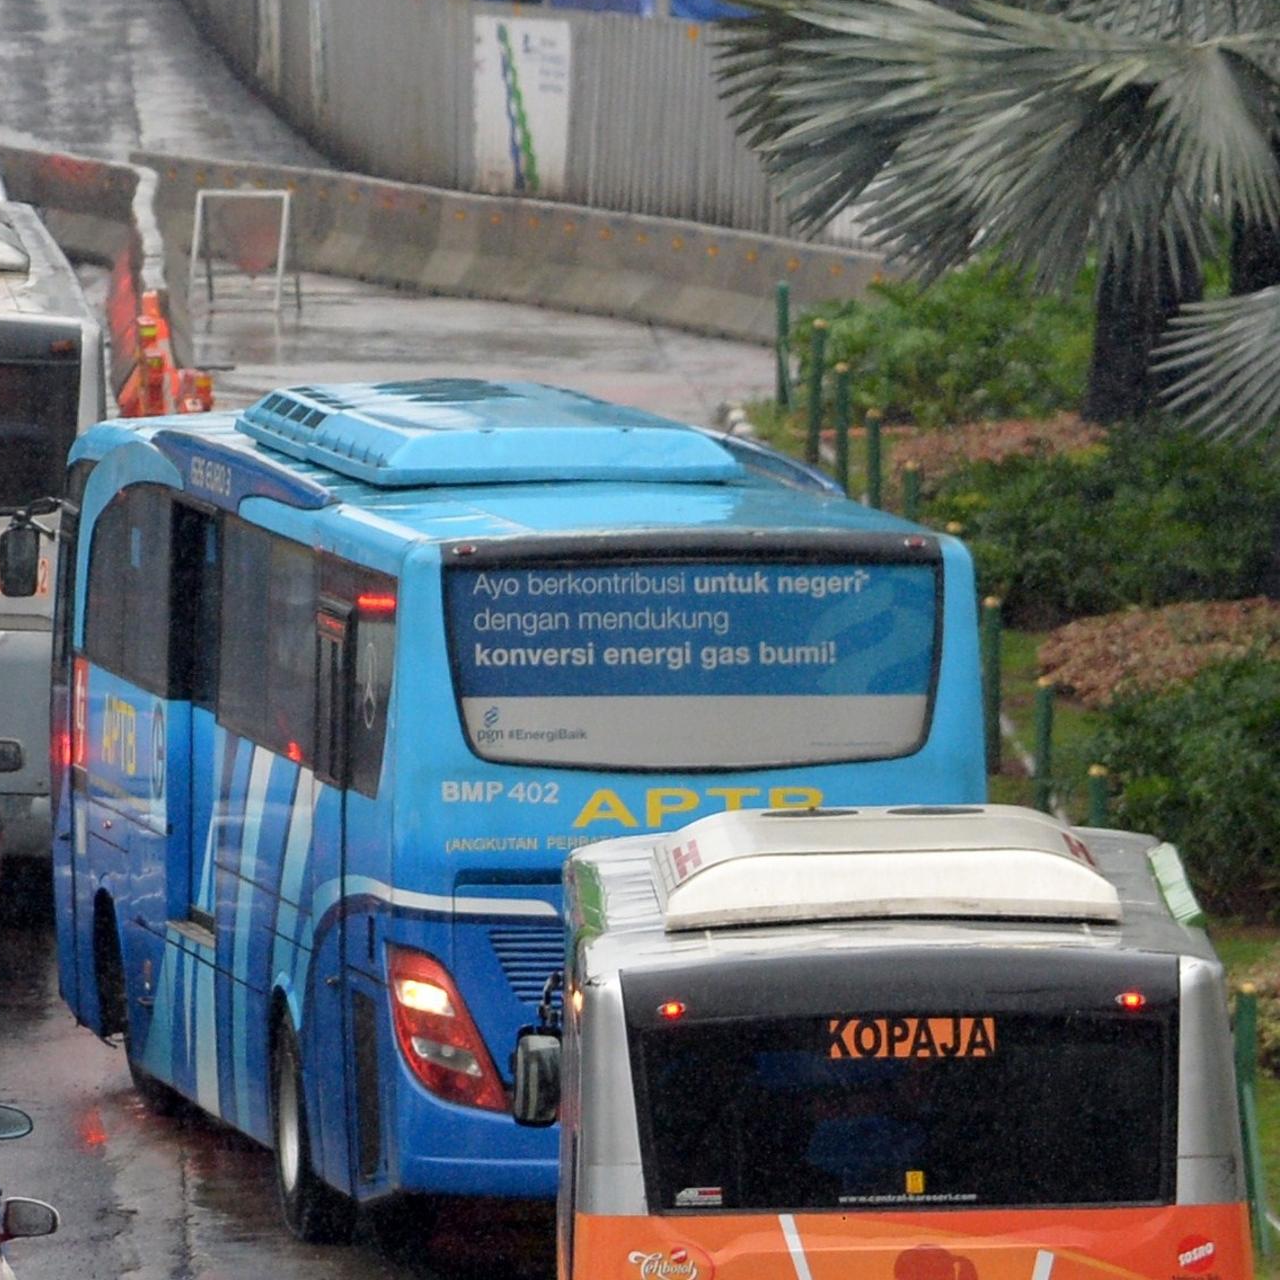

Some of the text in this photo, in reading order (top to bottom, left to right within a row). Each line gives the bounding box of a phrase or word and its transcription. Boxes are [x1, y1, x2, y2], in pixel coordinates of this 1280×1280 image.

[472, 573, 519, 600] Ayo
[528, 572, 686, 595] berkontribusi
[694, 572, 769, 594] untuk
[473, 608, 729, 636] dengan mendukung
[474, 641, 838, 670] konversi energi gas bumi!
[477, 728, 588, 743] pgn #EnergiBaik
[441, 781, 560, 804] BMP 402
[826, 1018, 996, 1059] KOPAJA
